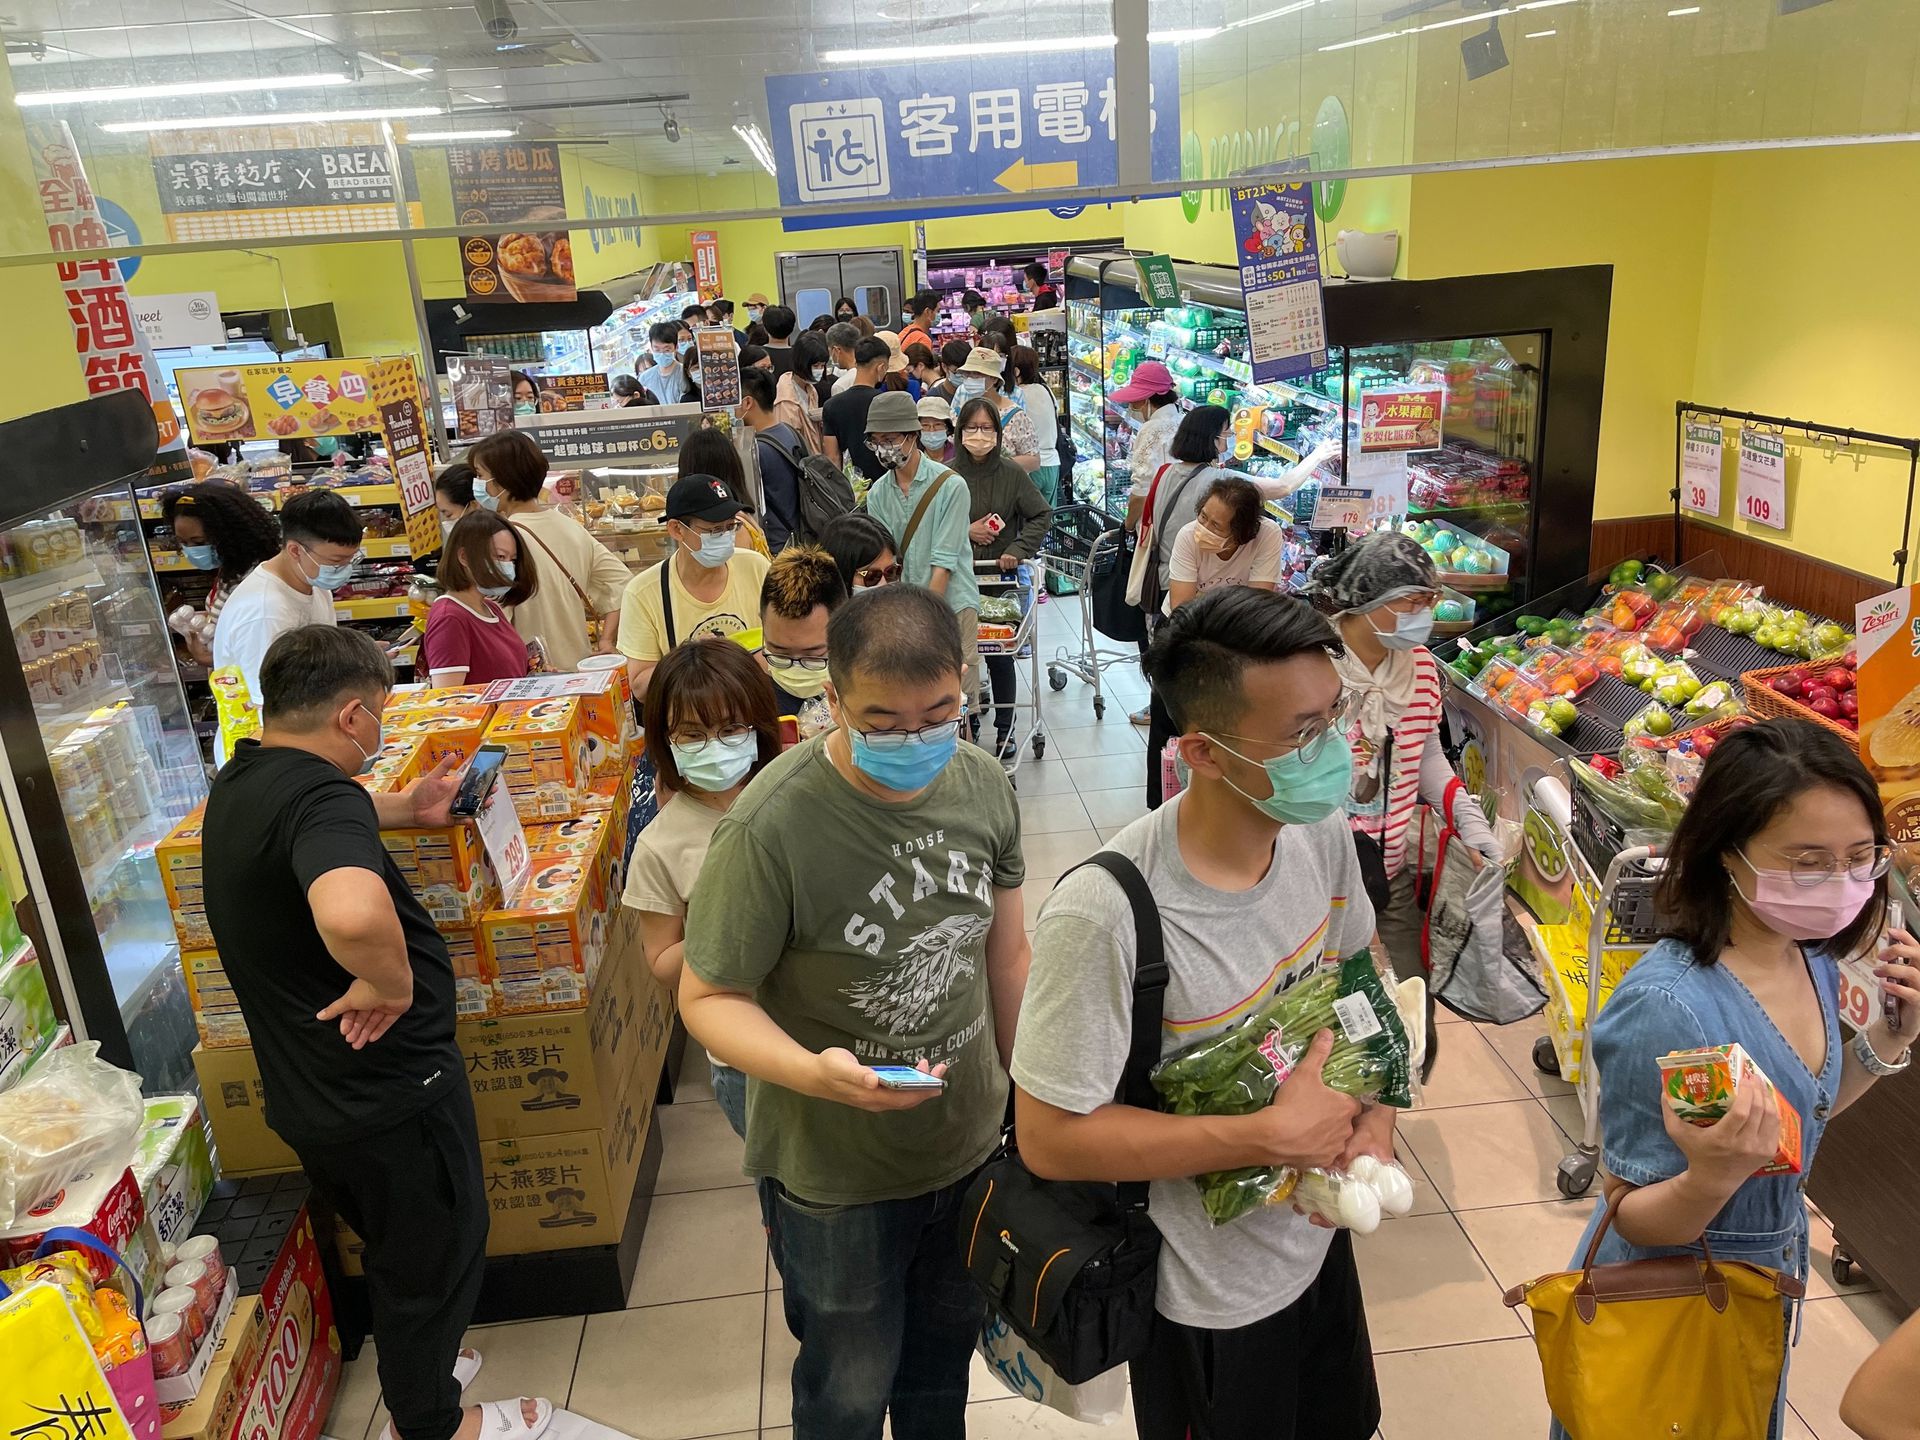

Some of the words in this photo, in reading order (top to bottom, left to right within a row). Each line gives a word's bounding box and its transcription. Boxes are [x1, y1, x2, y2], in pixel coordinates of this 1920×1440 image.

[321, 151, 391, 175] BREA
[480, 147, 554, 172] 烤地瓜
[1238, 185, 1266, 201] BT21
[247, 366, 293, 376] 在家吃早餐之
[556, 374, 605, 387] 黃金夯地瓜
[1386, 404, 1434, 419] 水果禮盒
[1364, 429, 1415, 443] 客製化服務
[406, 480, 430, 508] 100
[1692, 486, 1706, 508] 39
[1343, 512, 1359, 524] 179
[1746, 495, 1770, 520] 109
[1861, 607, 1901, 634] Zespri
[892, 829, 945, 857] HOUSE
[504, 834, 525, 880] 299
[930, 1044, 943, 1060] IS
[946, 1007, 987, 1053] COMIN
[465, 1043, 565, 1074] 大燕麥片
[473, 1075, 525, 1094] 效認證
[485, 1164, 583, 1193] 大燕麥片
[493, 1193, 543, 1212] 效認證
[258, 1314, 300, 1430] 100
